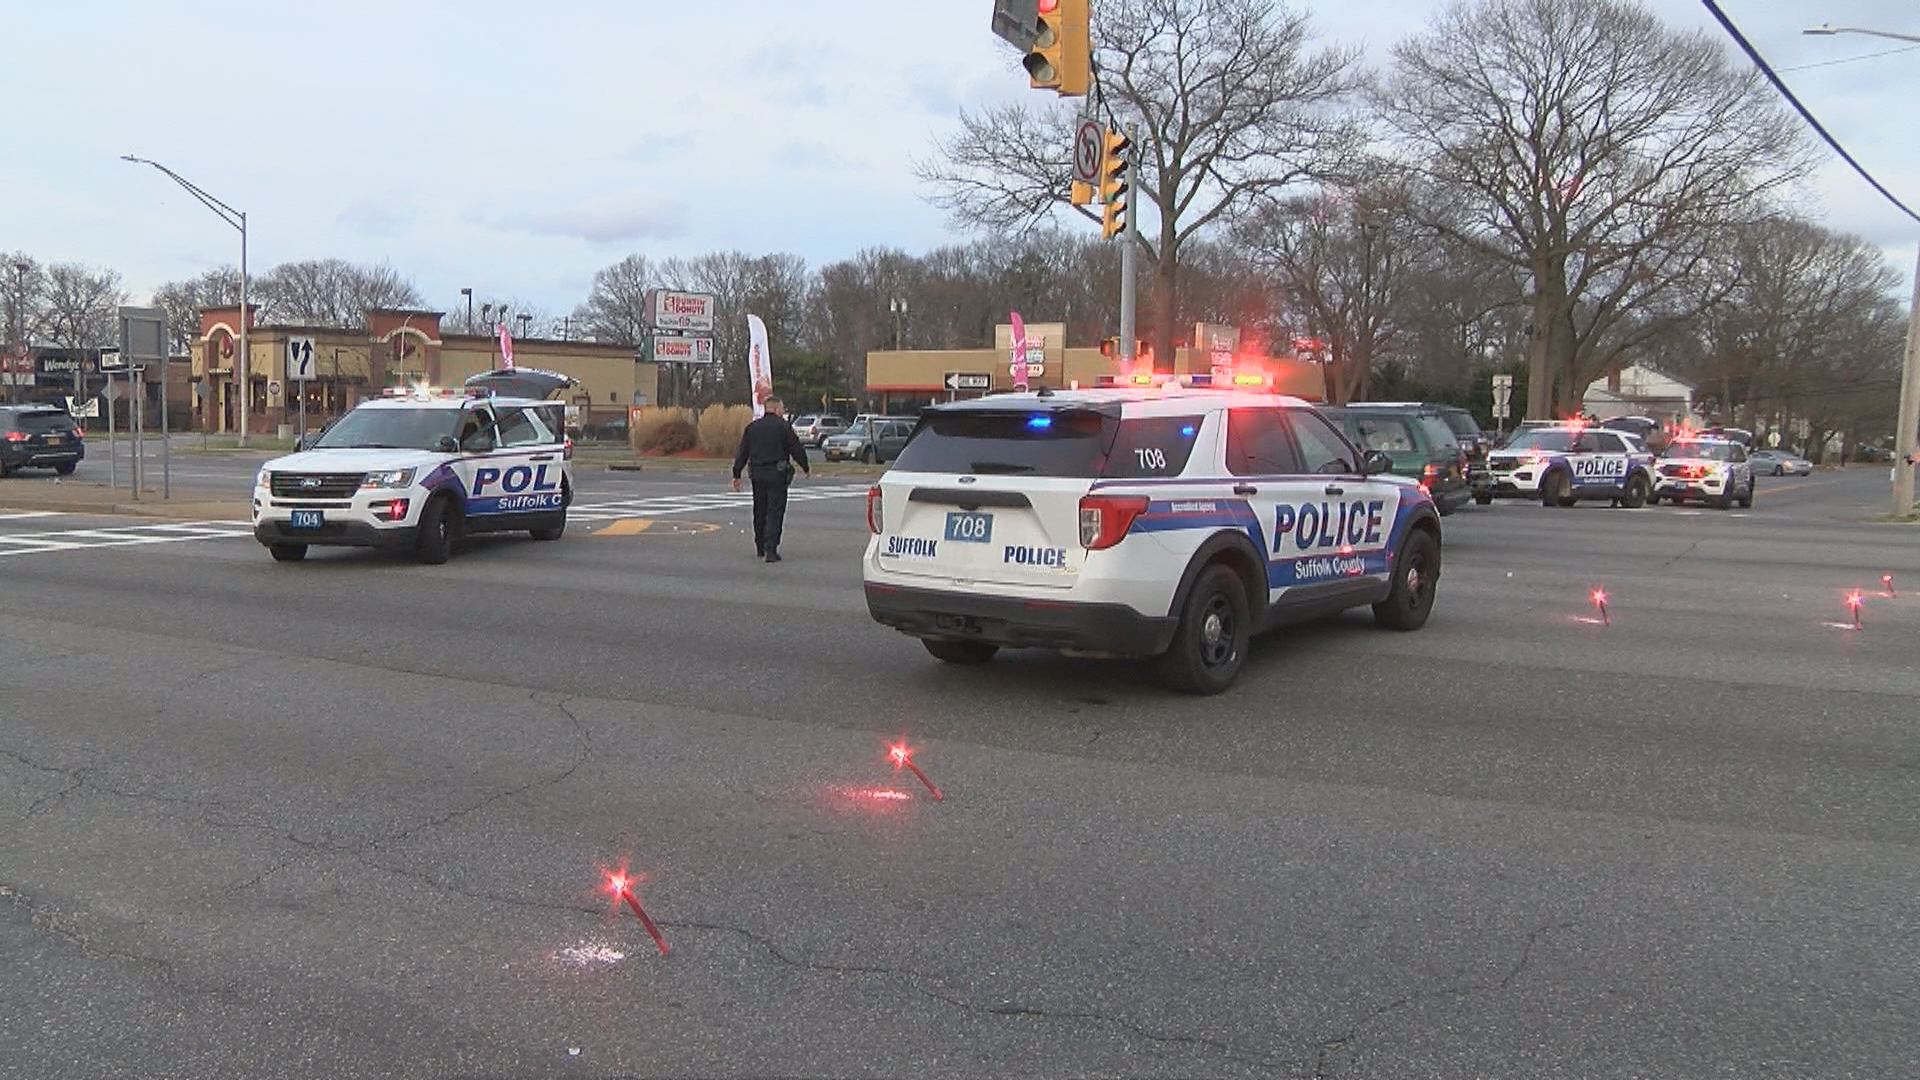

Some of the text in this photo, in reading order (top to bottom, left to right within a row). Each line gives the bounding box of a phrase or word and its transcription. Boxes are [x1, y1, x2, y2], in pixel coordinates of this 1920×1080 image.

[675, 304, 705, 315] DONUTS
[43, 359, 81, 373] Wendy's
[973, 376, 986, 387] WAY
[1134, 448, 1167, 470] 708
[1575, 460, 1624, 476] POLICE
[472, 464, 557, 496] POL
[498, 495, 547, 510] Suffolk
[295, 512, 318, 527] 704
[951, 515, 986, 538] 708
[1273, 500, 1384, 554] POLICE
[888, 536, 938, 558] SUFFOLK
[1003, 545, 1067, 568] POLICE
[1295, 556, 1365, 579] Suffolk County
